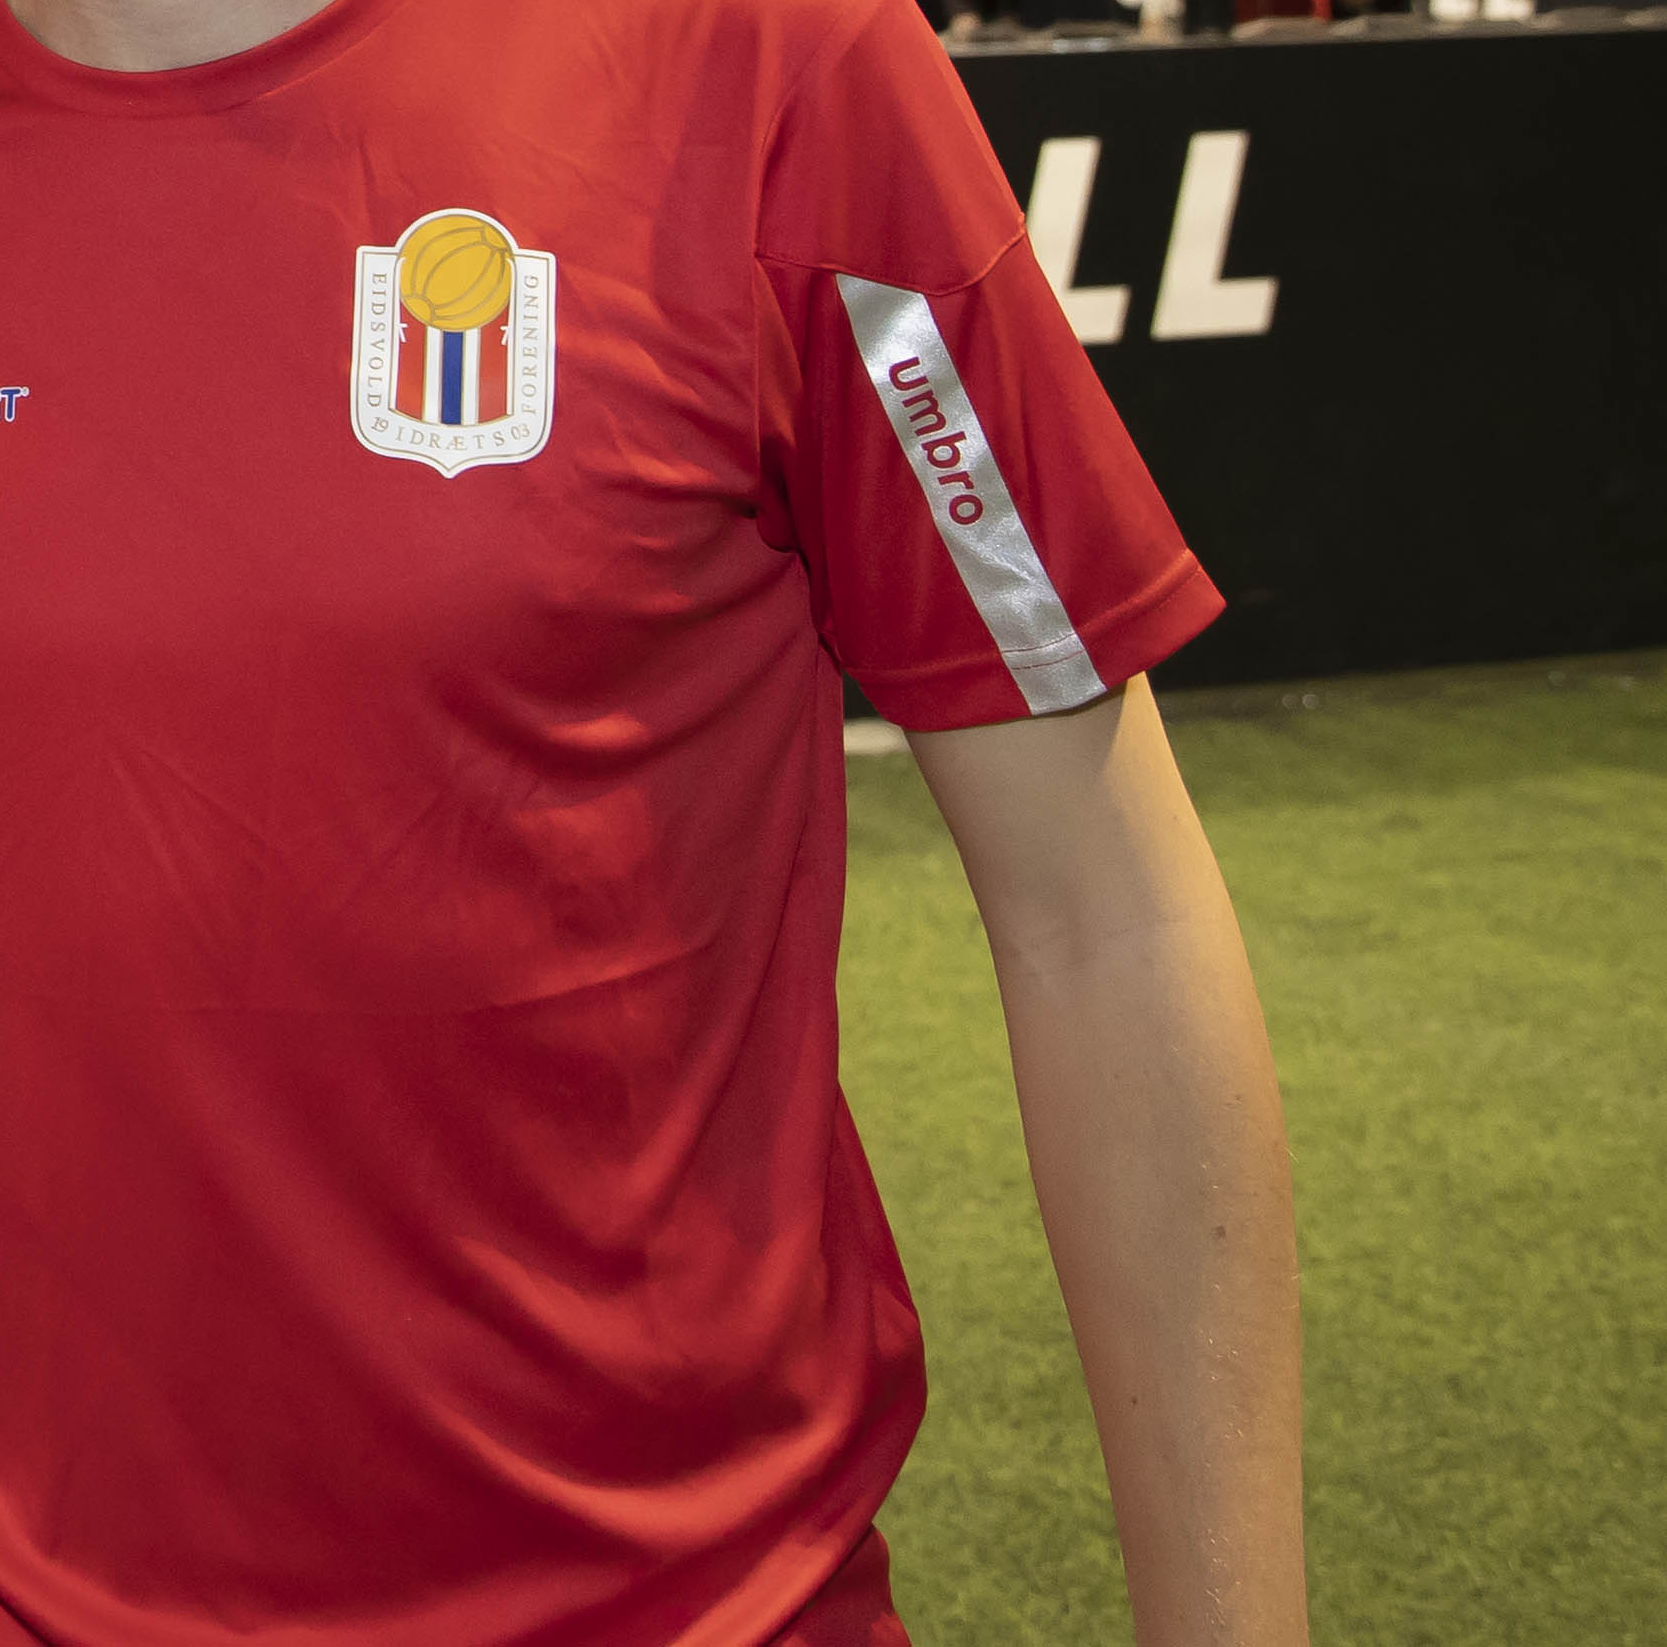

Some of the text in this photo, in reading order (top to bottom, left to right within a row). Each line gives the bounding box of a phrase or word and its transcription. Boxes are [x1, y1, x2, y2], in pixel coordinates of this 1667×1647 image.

[367, 272, 388, 408] EIDSVOLD
[521, 274, 540, 416] FORENING
[887, 356, 984, 526] umbro
